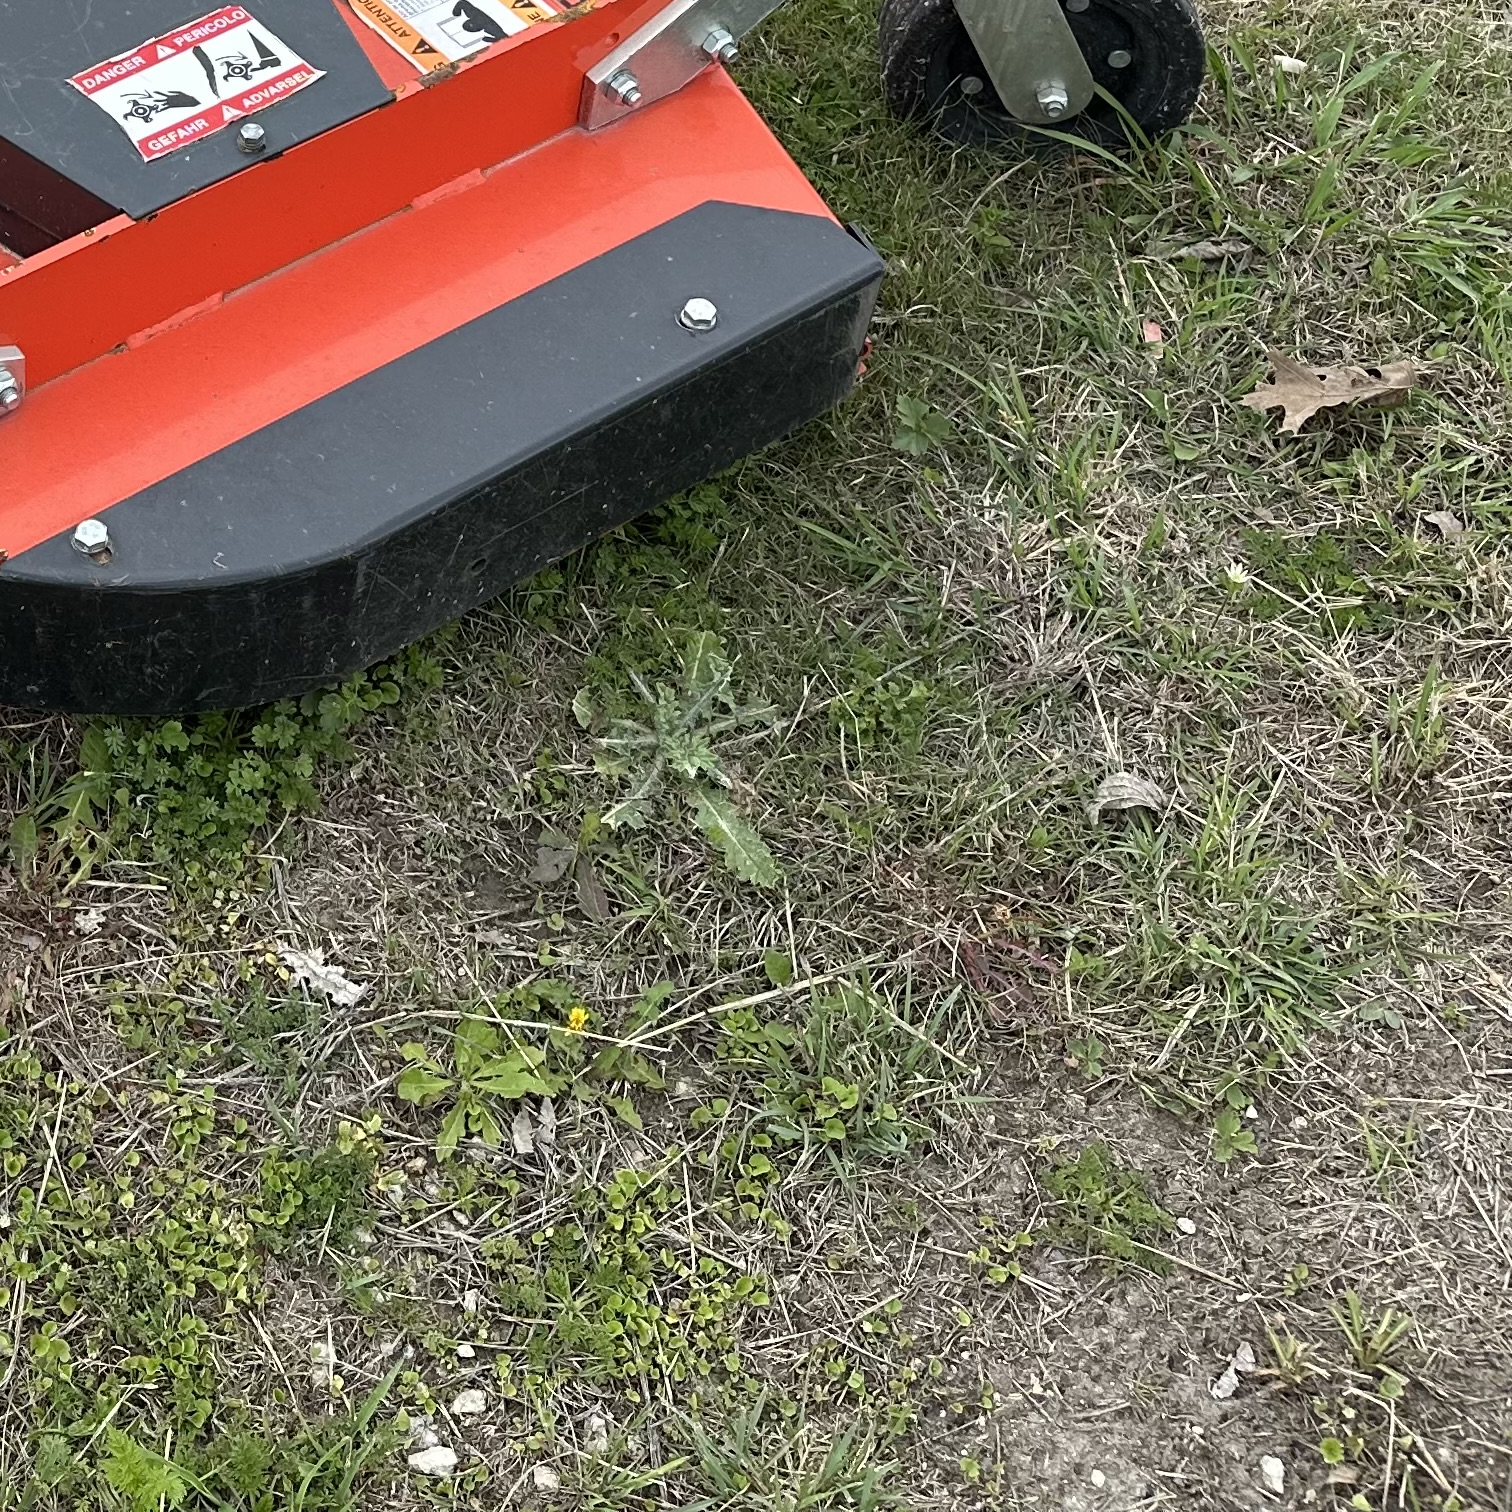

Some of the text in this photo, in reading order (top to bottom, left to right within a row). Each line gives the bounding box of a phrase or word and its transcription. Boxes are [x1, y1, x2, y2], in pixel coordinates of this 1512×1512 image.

[82, 9, 246, 90] DANGER PERICOLO
[147, 70, 314, 152] GEFAHR ADVARSEL
